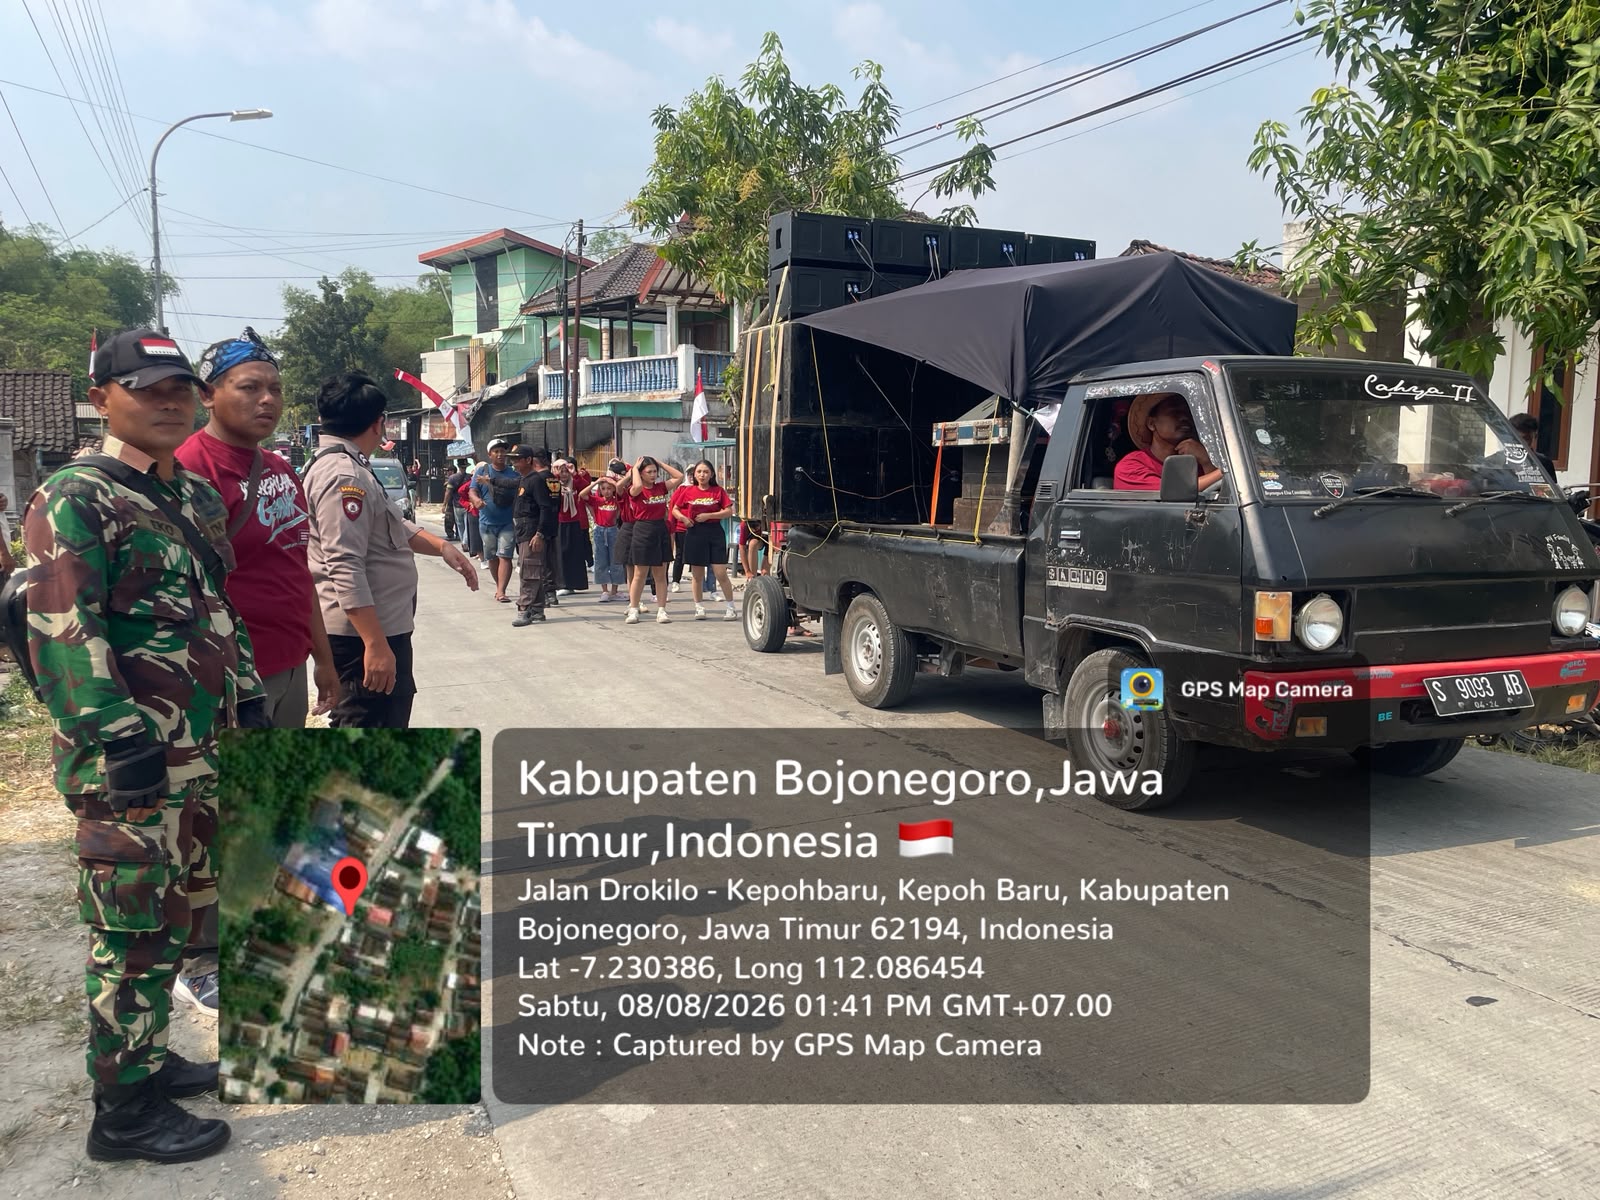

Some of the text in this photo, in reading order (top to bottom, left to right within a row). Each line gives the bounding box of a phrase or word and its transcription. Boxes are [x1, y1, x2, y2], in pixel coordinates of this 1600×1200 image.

[1431, 673, 1524, 702] S 9093 AB
[1377, 711, 1393, 722] BE
